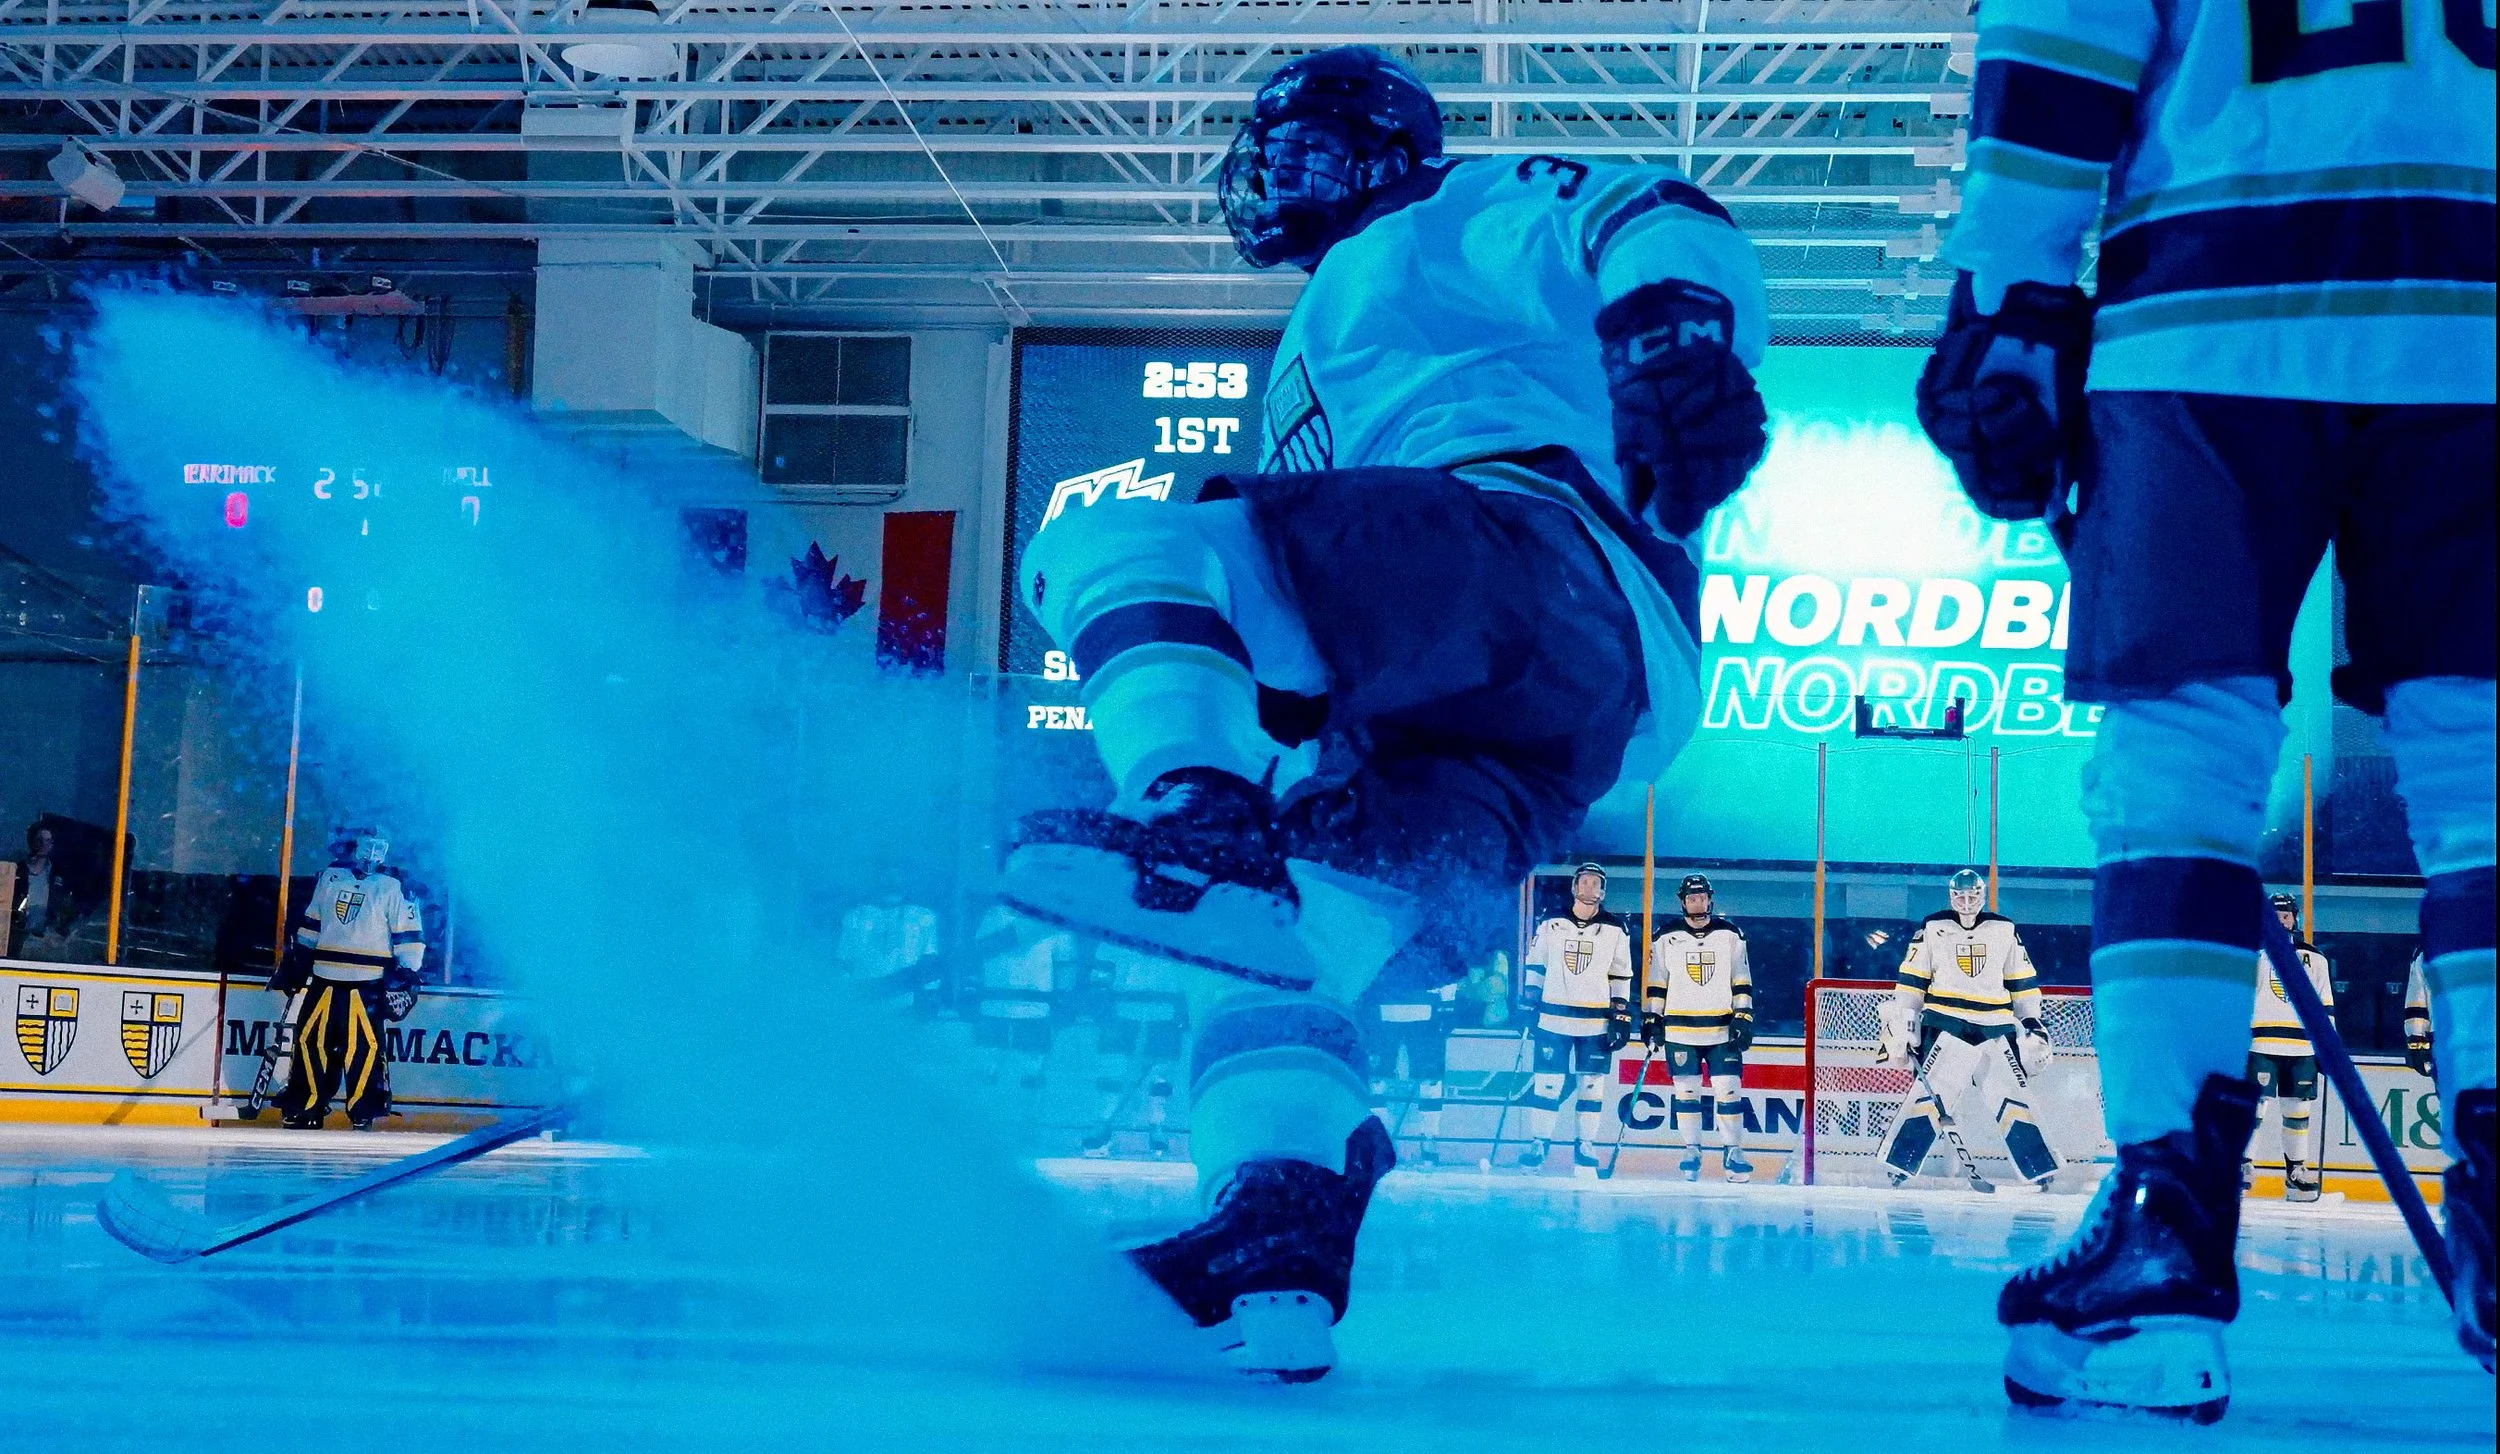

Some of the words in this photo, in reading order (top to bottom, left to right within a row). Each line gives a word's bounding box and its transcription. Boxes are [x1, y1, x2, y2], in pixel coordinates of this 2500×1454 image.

[1143, 361, 1248, 399] 2:53
[1154, 417, 1239, 454] 1ST
[1027, 704, 1094, 731] PEN
[251, 1060, 273, 1110] CCM
[1948, 1131, 1982, 1180] CCM
